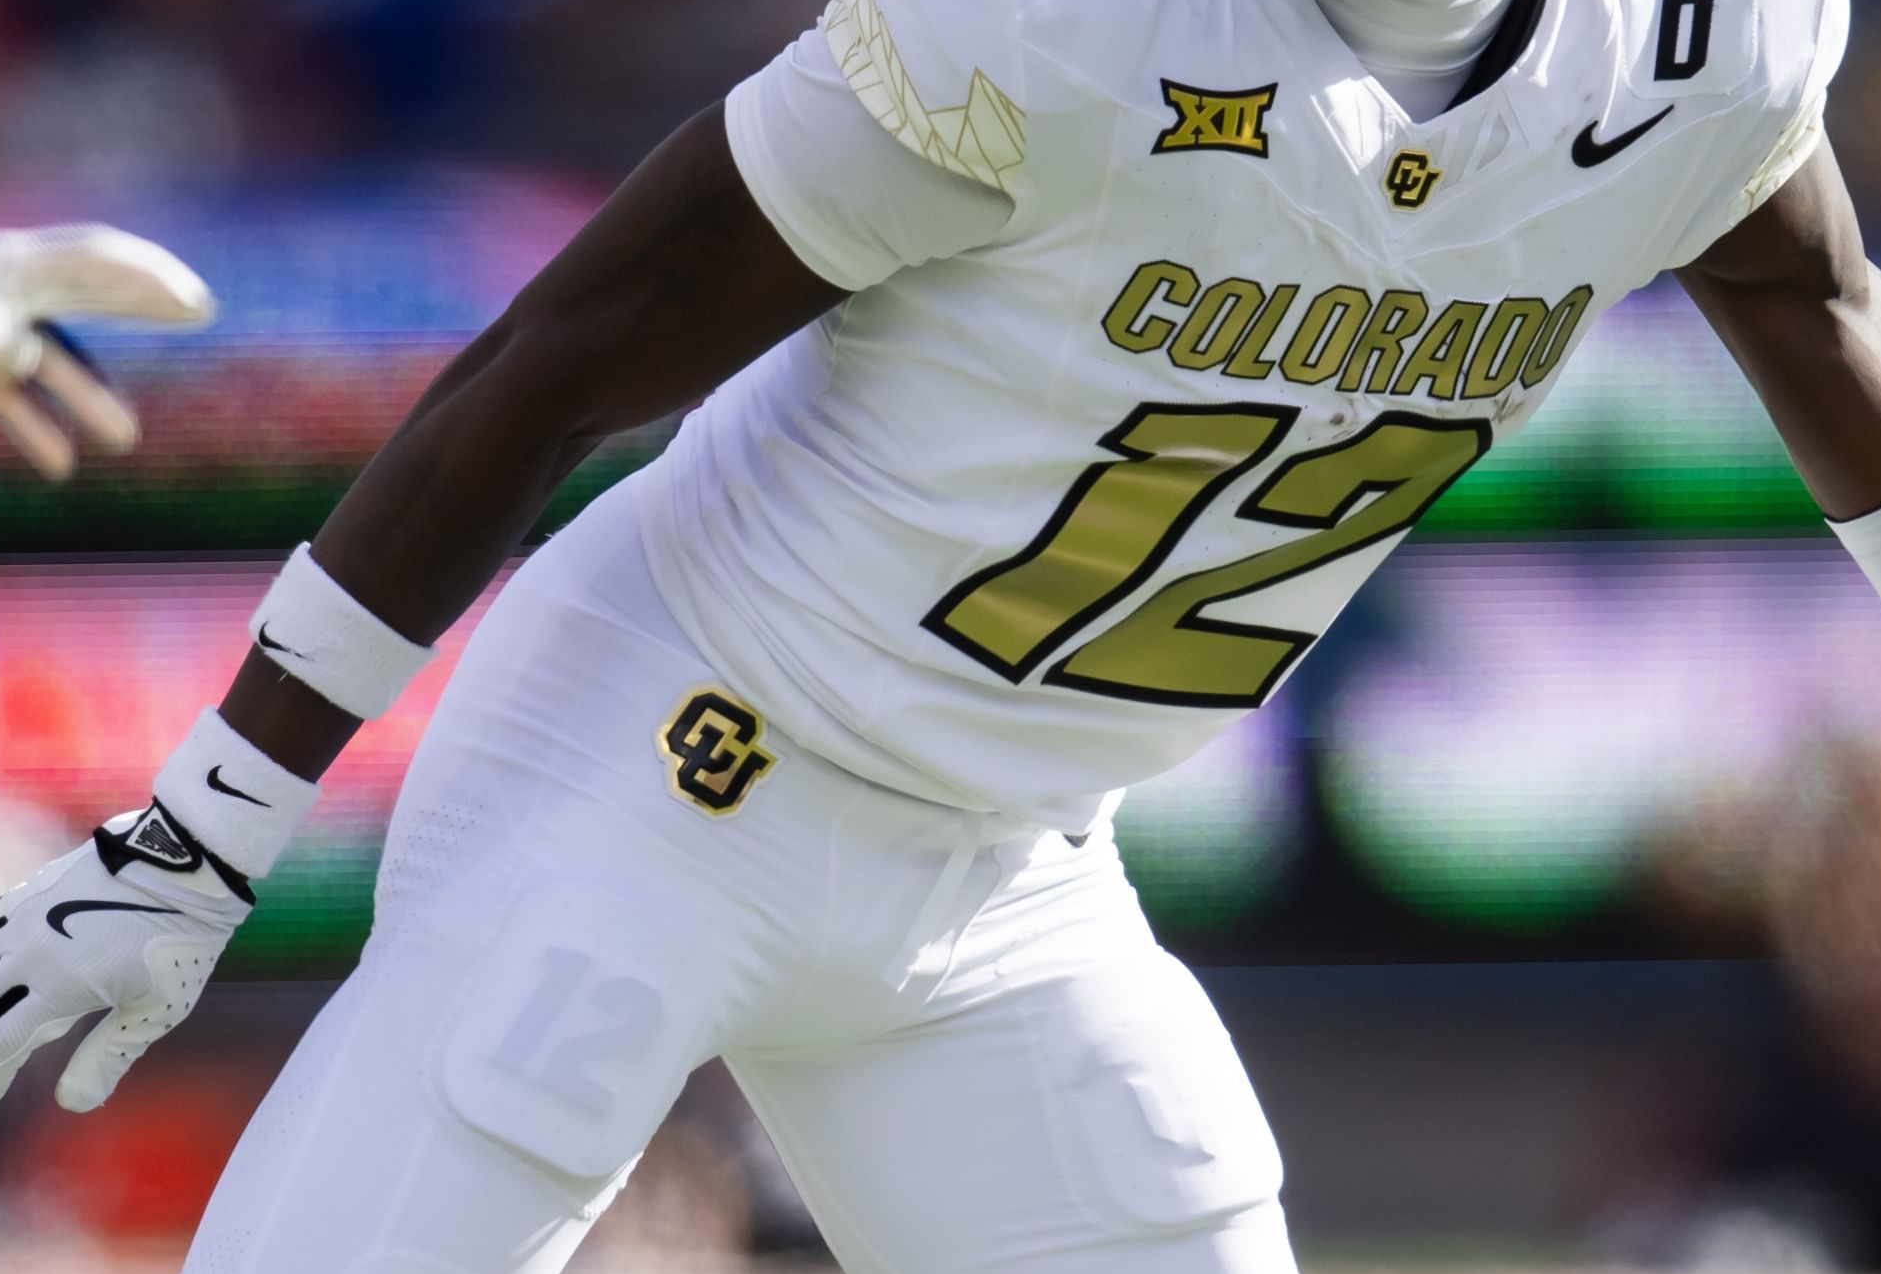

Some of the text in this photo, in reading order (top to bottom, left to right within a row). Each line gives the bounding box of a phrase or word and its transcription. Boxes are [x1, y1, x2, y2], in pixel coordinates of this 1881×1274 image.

[1387, 151, 1439, 209] CU
[1100, 259, 1594, 400] COLORADO
[919, 401, 1494, 709] 12
[662, 689, 774, 813] CU
